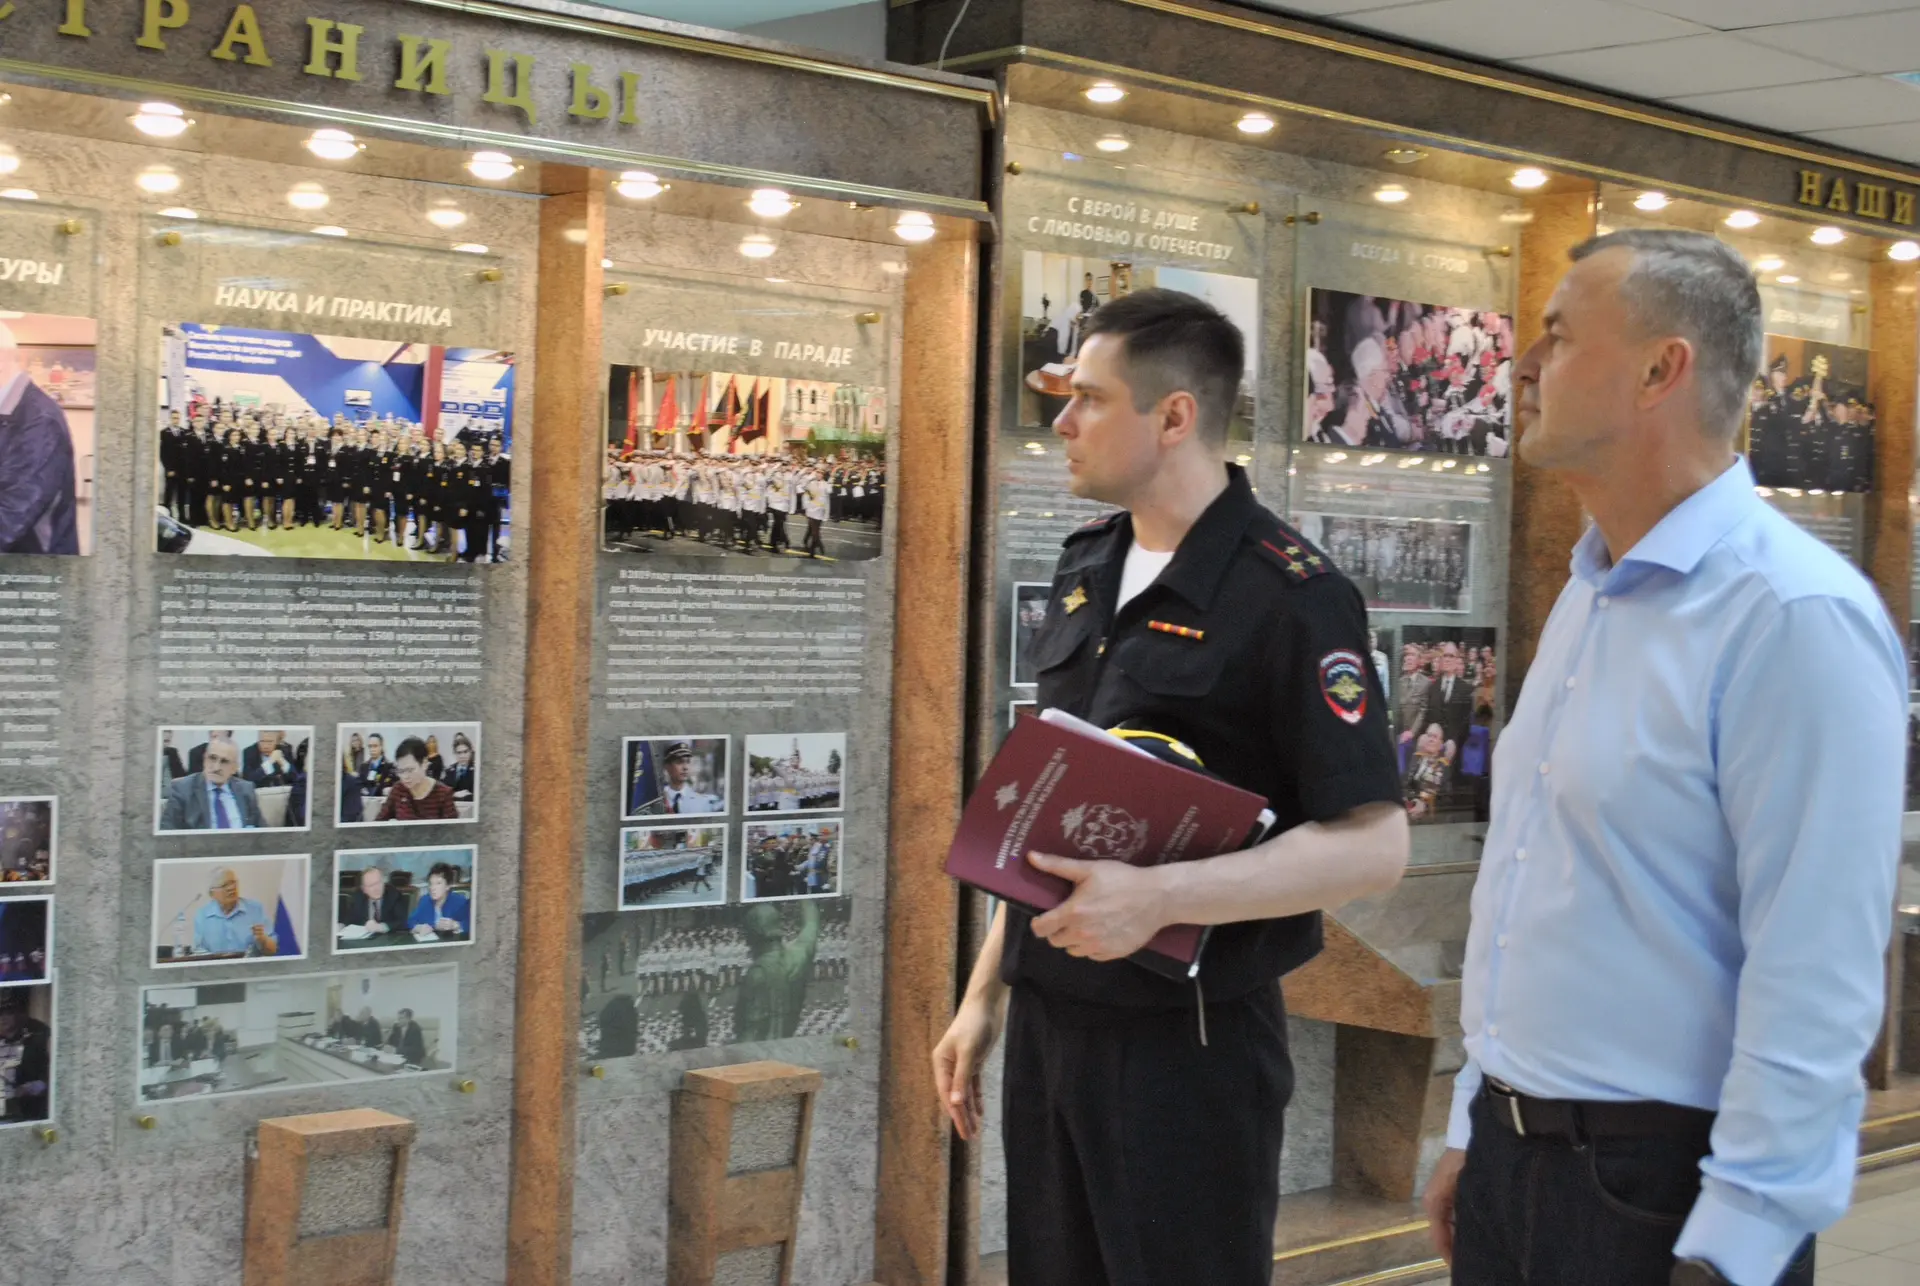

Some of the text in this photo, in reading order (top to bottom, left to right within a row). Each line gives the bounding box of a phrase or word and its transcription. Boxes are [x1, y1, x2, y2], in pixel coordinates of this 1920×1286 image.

[0, 0, 641, 124] ТРАНИЦЫ
[1067, 197, 1199, 232] С ВЕРОЙ В ДУШЕ
[1799, 170, 1915, 225] НАШИ
[1028, 216, 1234, 260] С ЛЮБОВЬЮ К ОТЕЧЕСТВУ
[215, 286, 453, 327] НАУКА И ПРАКТИКА
[642, 329, 853, 367] УЧАСТИЕ В ПАРАДЕ
